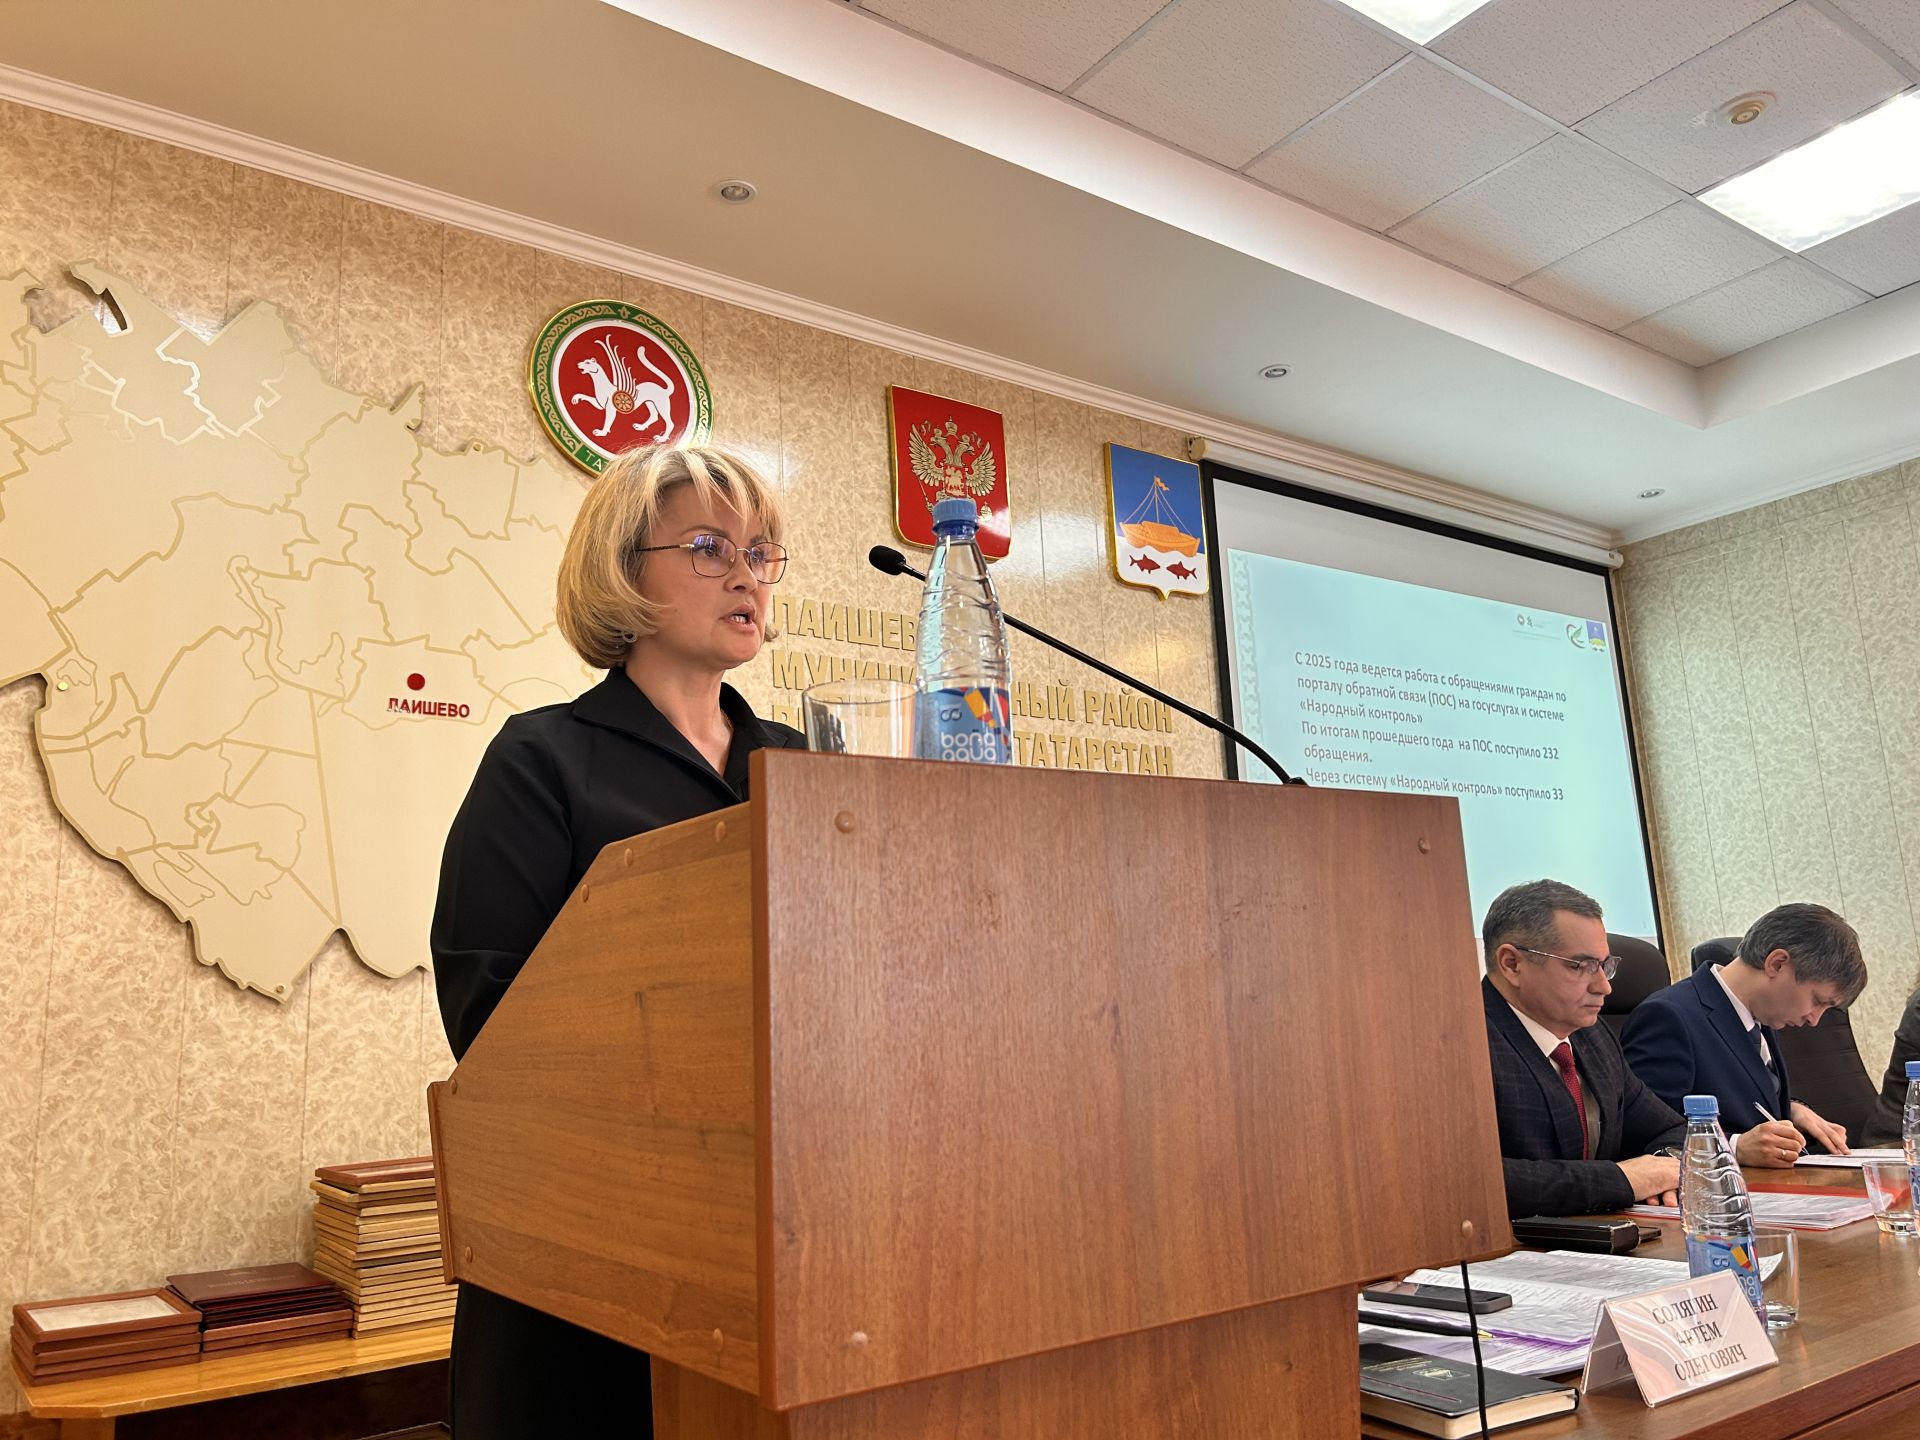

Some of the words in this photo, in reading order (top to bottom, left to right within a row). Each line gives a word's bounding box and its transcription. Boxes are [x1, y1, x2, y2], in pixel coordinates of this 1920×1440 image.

[772, 594, 917, 651] ЛАИШЕВ
[1295, 651, 1303, 665] С
[1305, 652, 1331, 669] 2025
[1334, 659, 1359, 675] года
[1361, 663, 1402, 679] ведется
[1404, 668, 1438, 685] работа
[1440, 675, 1446, 685] с
[1448, 674, 1514, 695] обращениями
[1516, 686, 1554, 702] граждан
[1555, 691, 1567, 702] по
[386, 697, 470, 718] ЛАИШЕВО
[1084, 687, 1172, 733] РАЙОН
[1297, 677, 1342, 696] порталу
[1345, 681, 1396, 700] обратной
[1398, 689, 1426, 703] связи
[1428, 690, 1456, 710] (ПОС)
[1458, 698, 1470, 709] на
[1472, 700, 1519, 717] госуслугах
[1521, 708, 1527, 717] и
[1529, 708, 1565, 722] системе
[1299, 698, 1366, 718] «Народный
[1368, 708, 1423, 725] контроль»
[1013, 730, 1173, 776] ТАТАРСТАН
[1301, 720, 1317, 735] По
[1320, 726, 1360, 740] итогам
[1362, 729, 1430, 747] прошедшего
[1431, 737, 1454, 751] года
[1458, 739, 1471, 751] на
[1472, 739, 1493, 753] ПОС
[1494, 744, 1541, 759] поступило
[1542, 746, 1559, 760] 232
[1304, 744, 1373, 763] обращения.
[1306, 767, 1340, 783] Через
[1343, 773, 1387, 789] систему
[1390, 774, 1450, 792] «Народный
[1452, 781, 1502, 797] контроль»
[1504, 787, 1551, 801] поступило
[1552, 788, 1564, 801] 33
[1674, 1344, 1748, 1380] ОЛЕГОВИЧ
